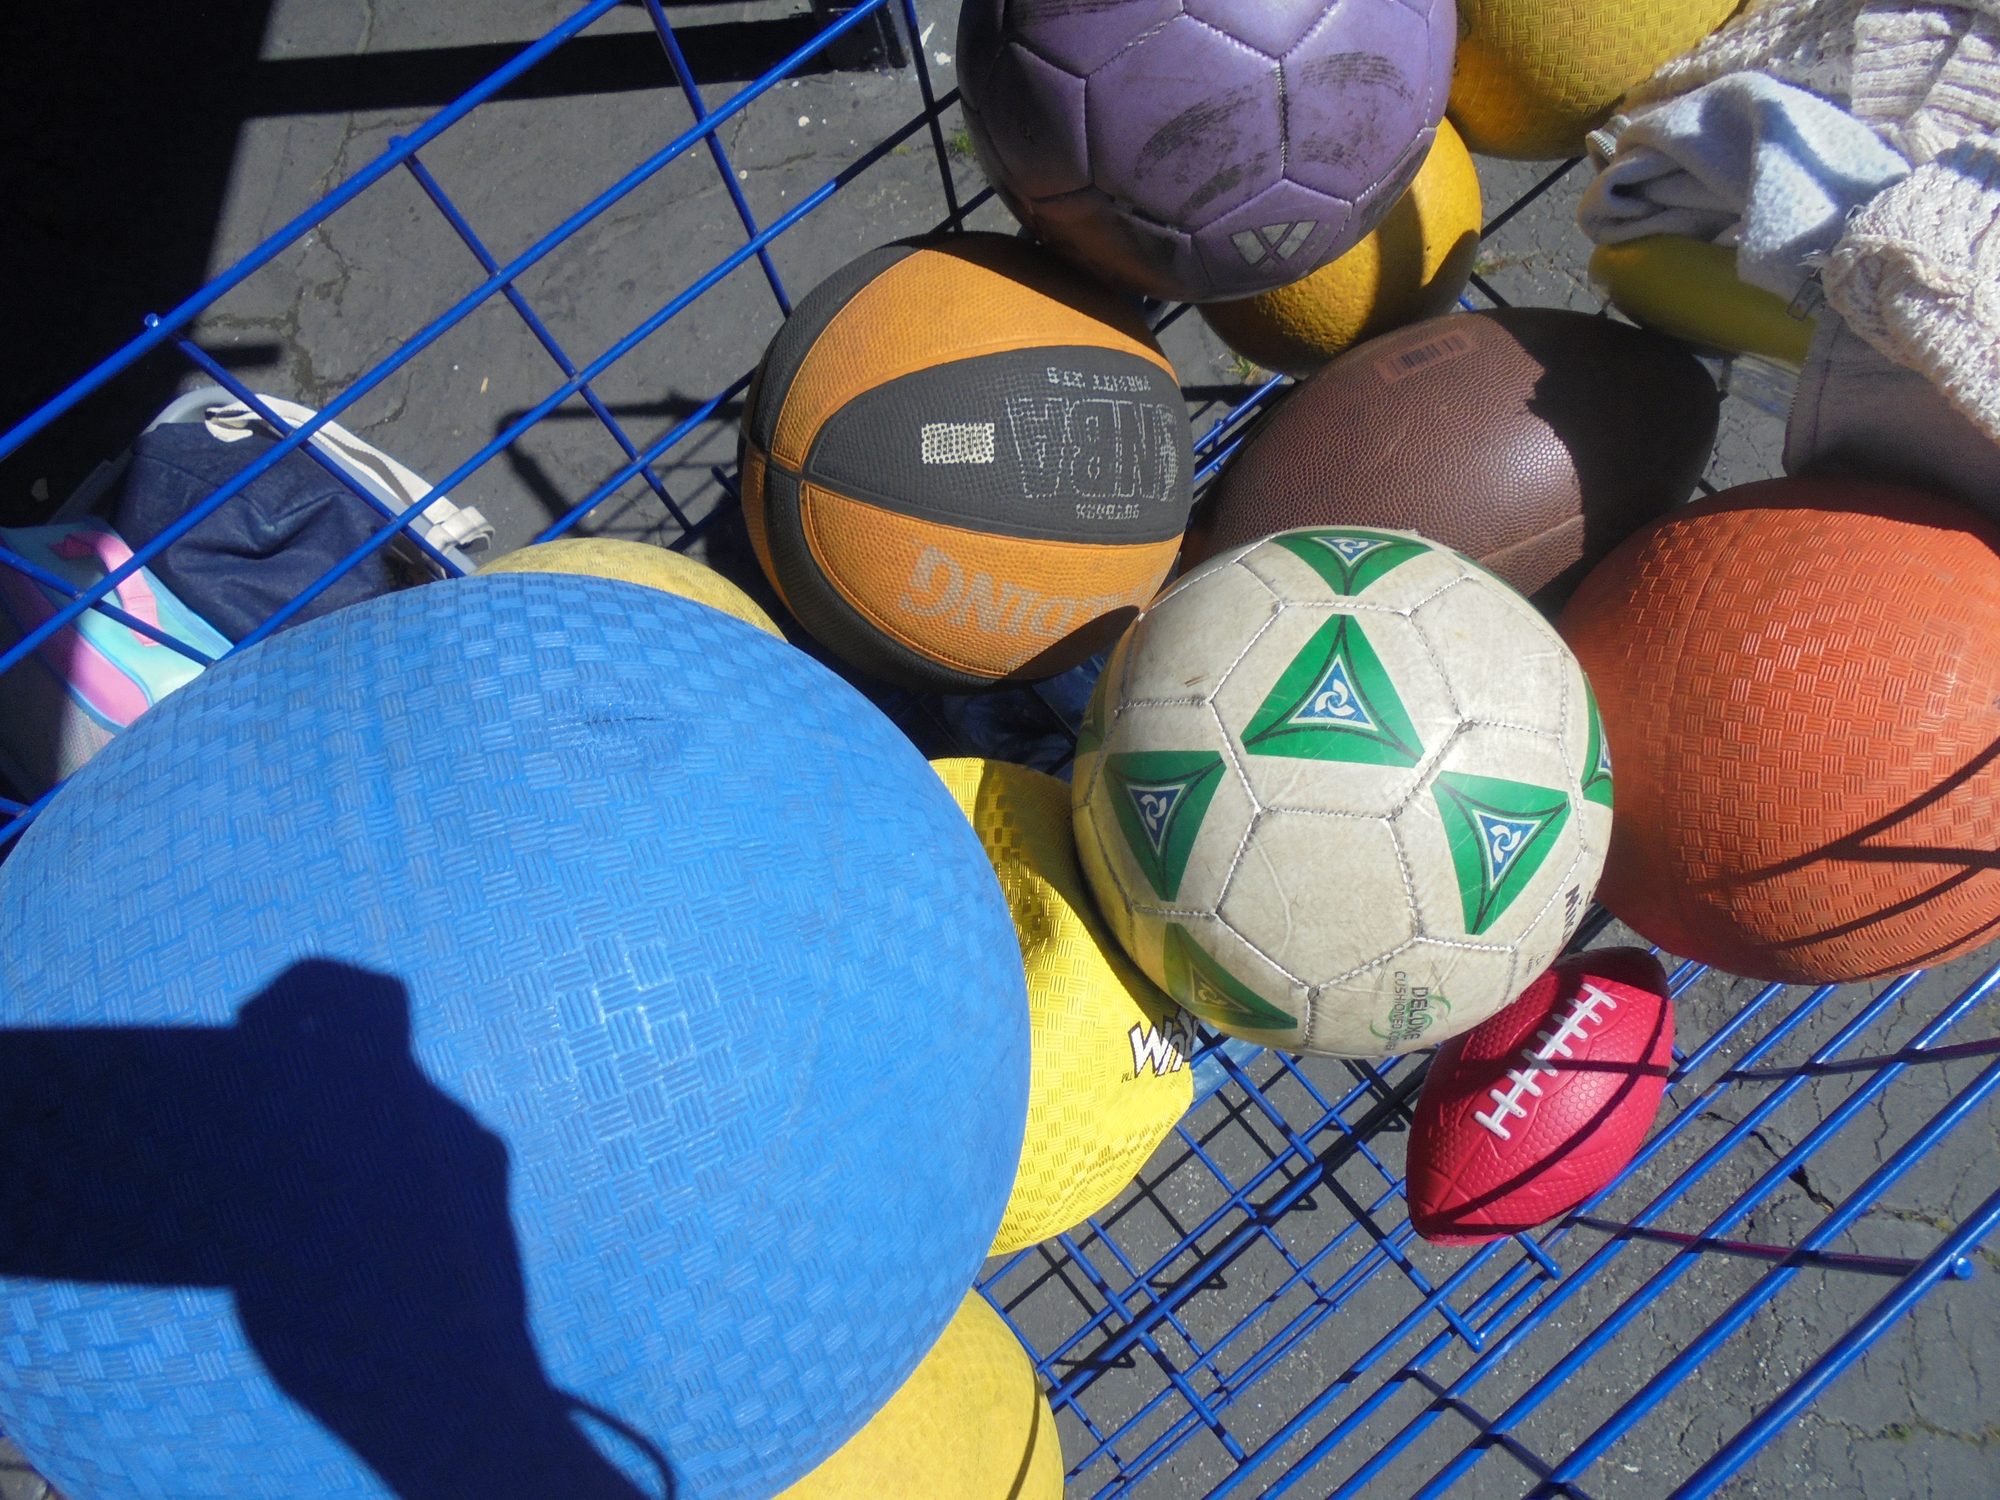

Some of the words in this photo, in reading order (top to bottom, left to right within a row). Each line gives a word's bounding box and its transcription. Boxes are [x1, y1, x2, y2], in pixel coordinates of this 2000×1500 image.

[1005, 397, 1158, 499] NBA
[1392, 971, 1407, 1030] CUSHIONED
[1404, 986, 1429, 1041] DELUXE
